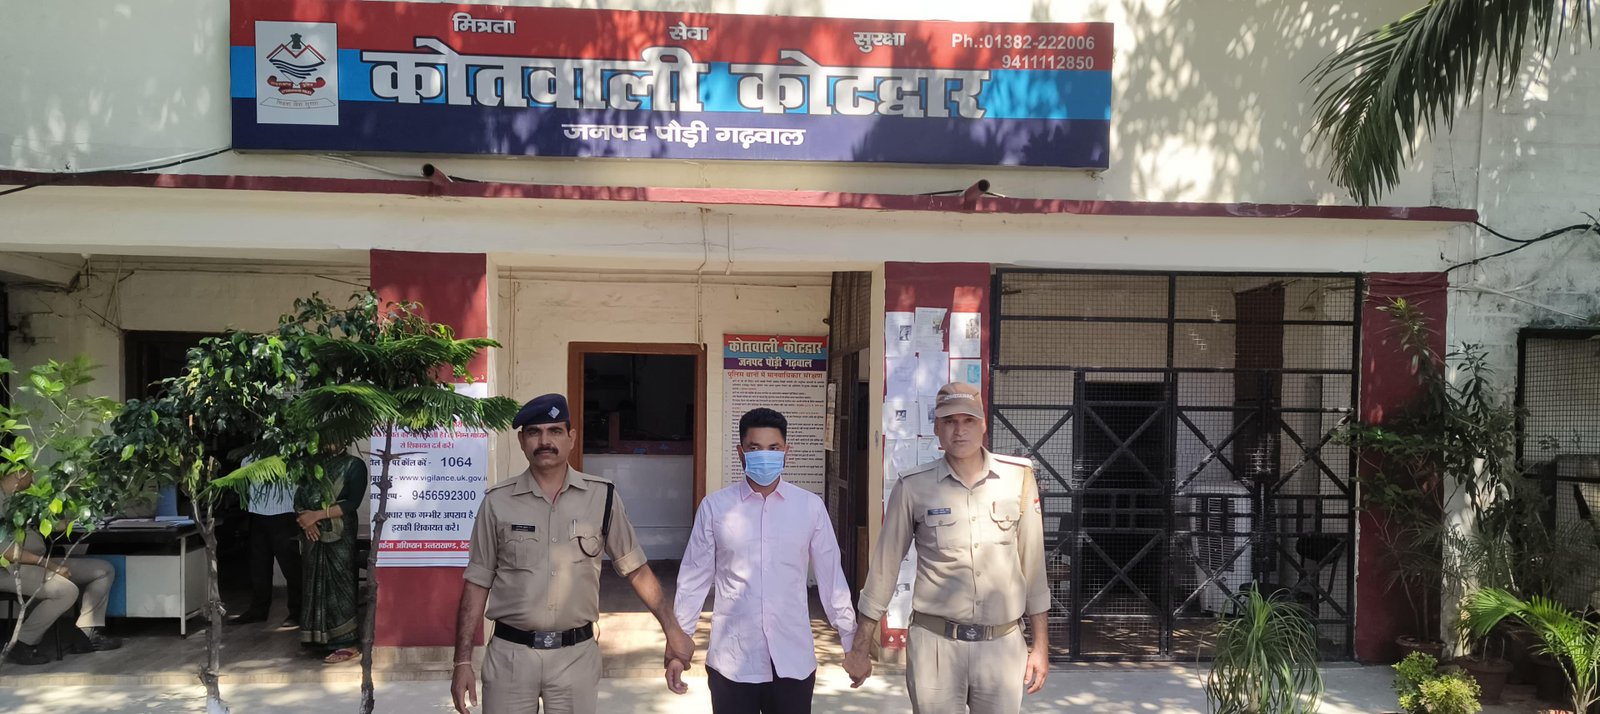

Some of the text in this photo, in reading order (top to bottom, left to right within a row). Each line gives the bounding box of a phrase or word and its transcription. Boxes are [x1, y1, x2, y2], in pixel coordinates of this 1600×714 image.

[452, 12, 906, 52] मित्रता सेवा सुरक्षा
[951, 33, 1095, 49] Ph.:01382-222006
[1002, 54, 1094, 69] 9411112850
[360, 36, 991, 120] कोतवाली कोटद्वार
[561, 120, 806, 150] जनपद पौड़ी गढ़वाल
[728, 337, 822, 354] कोतवाली कोटद्वार
[738, 356, 813, 369] जनपद पौड़ी गढ़वाल
[441, 456, 472, 467] 1064
[412, 490, 476, 500] 9456592300
[404, 511, 417, 519] एक
[391, 522, 411, 533] इसकी
[414, 522, 443, 531] शिकायत
